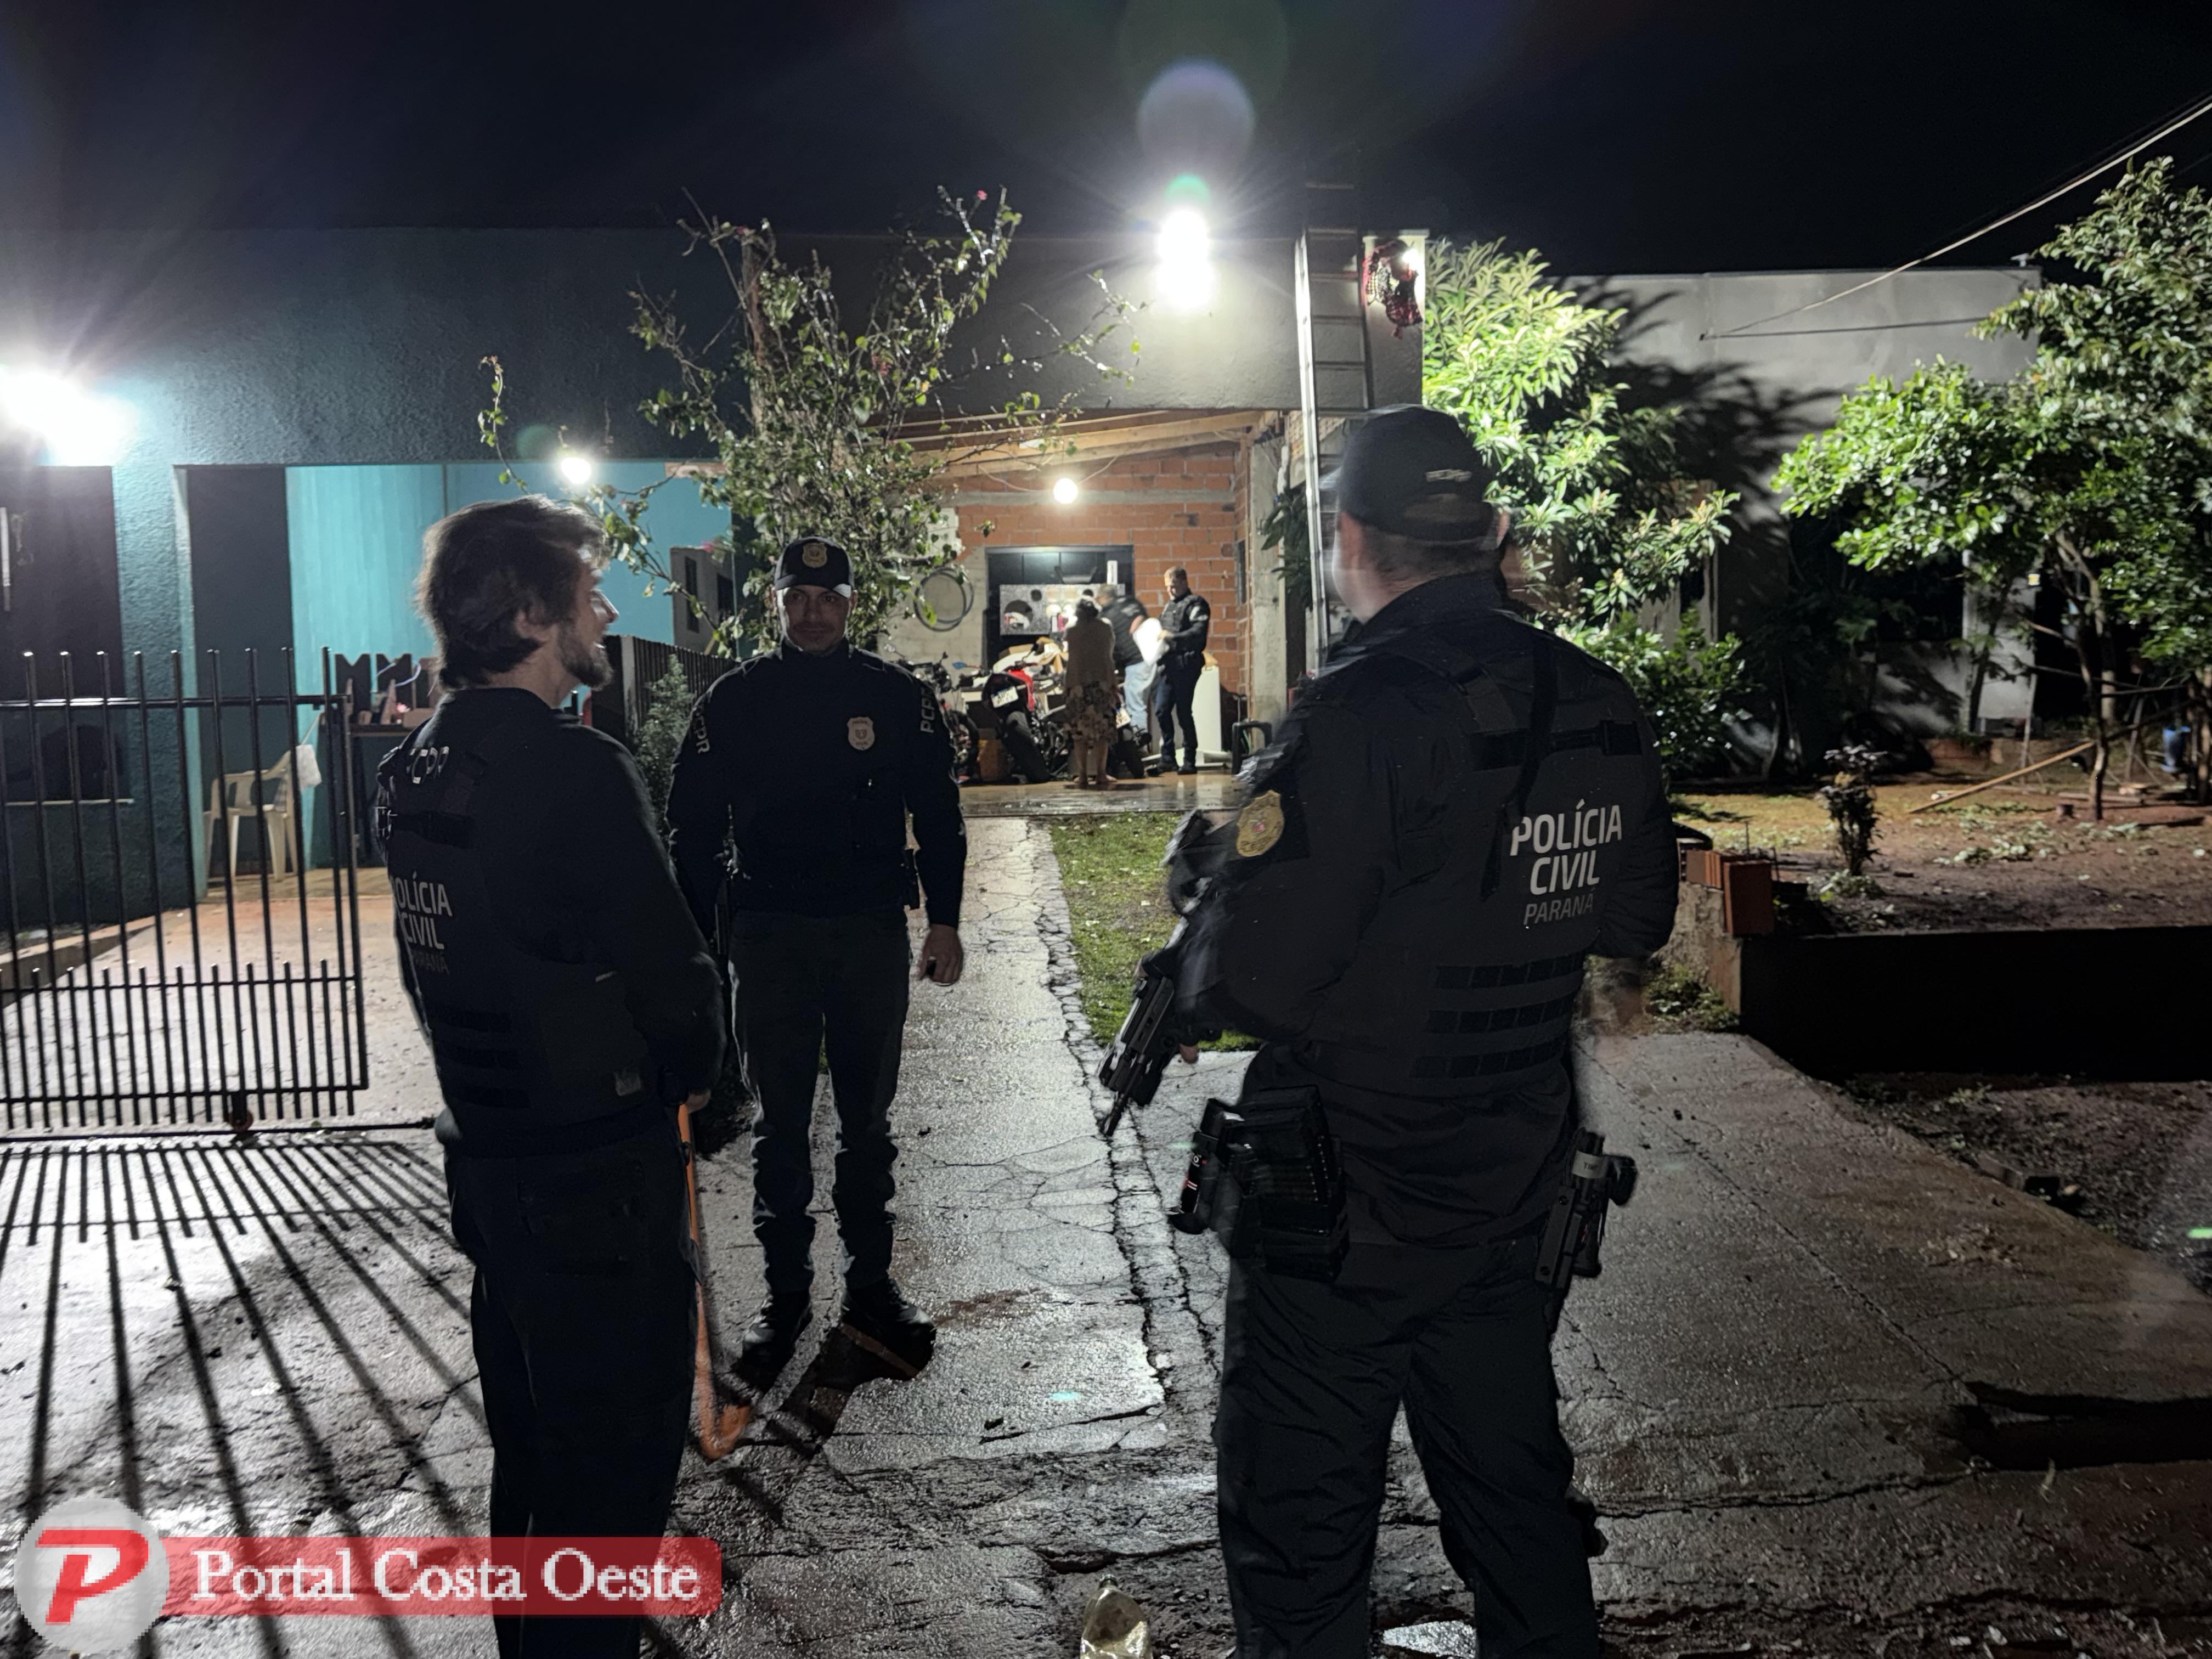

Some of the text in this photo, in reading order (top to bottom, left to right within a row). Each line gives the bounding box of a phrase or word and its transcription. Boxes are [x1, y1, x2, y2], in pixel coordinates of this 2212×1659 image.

[1510, 798, 1623, 856] POLÍCIA
[390, 870, 453, 917] OLÍCIA
[1530, 850, 1600, 895] CIVIL
[1523, 887, 1596, 926] PARANÁ
[400, 912, 445, 950] CIVIL
